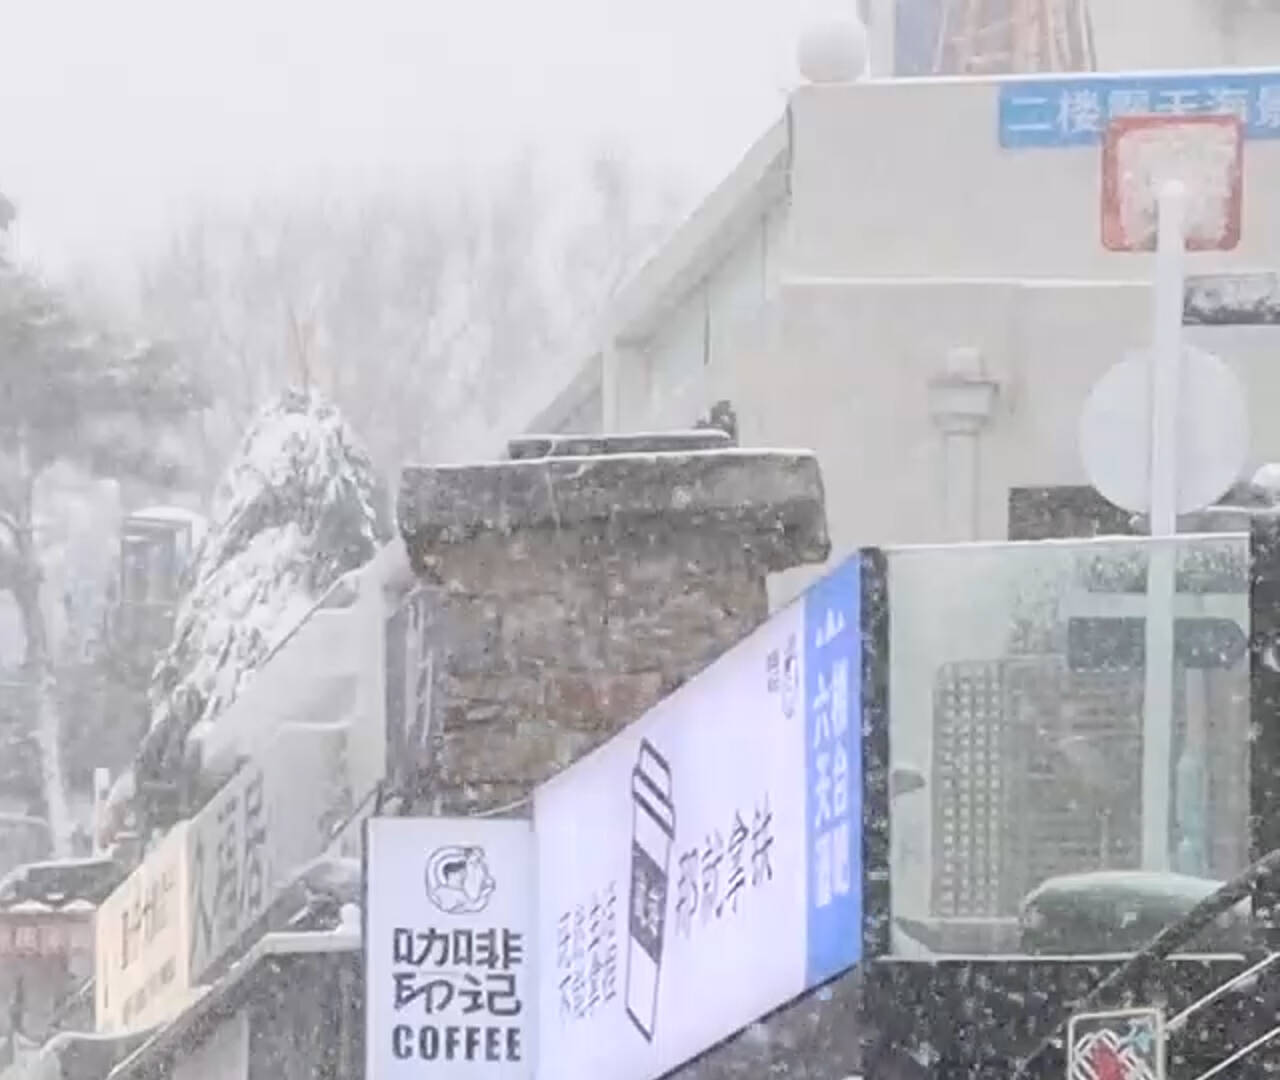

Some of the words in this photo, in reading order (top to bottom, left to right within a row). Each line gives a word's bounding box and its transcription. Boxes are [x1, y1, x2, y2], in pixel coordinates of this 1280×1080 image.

[393, 928, 522, 969] 咖啡
[393, 973, 522, 1016] 印记
[391, 1025, 522, 1062] COFFEE
